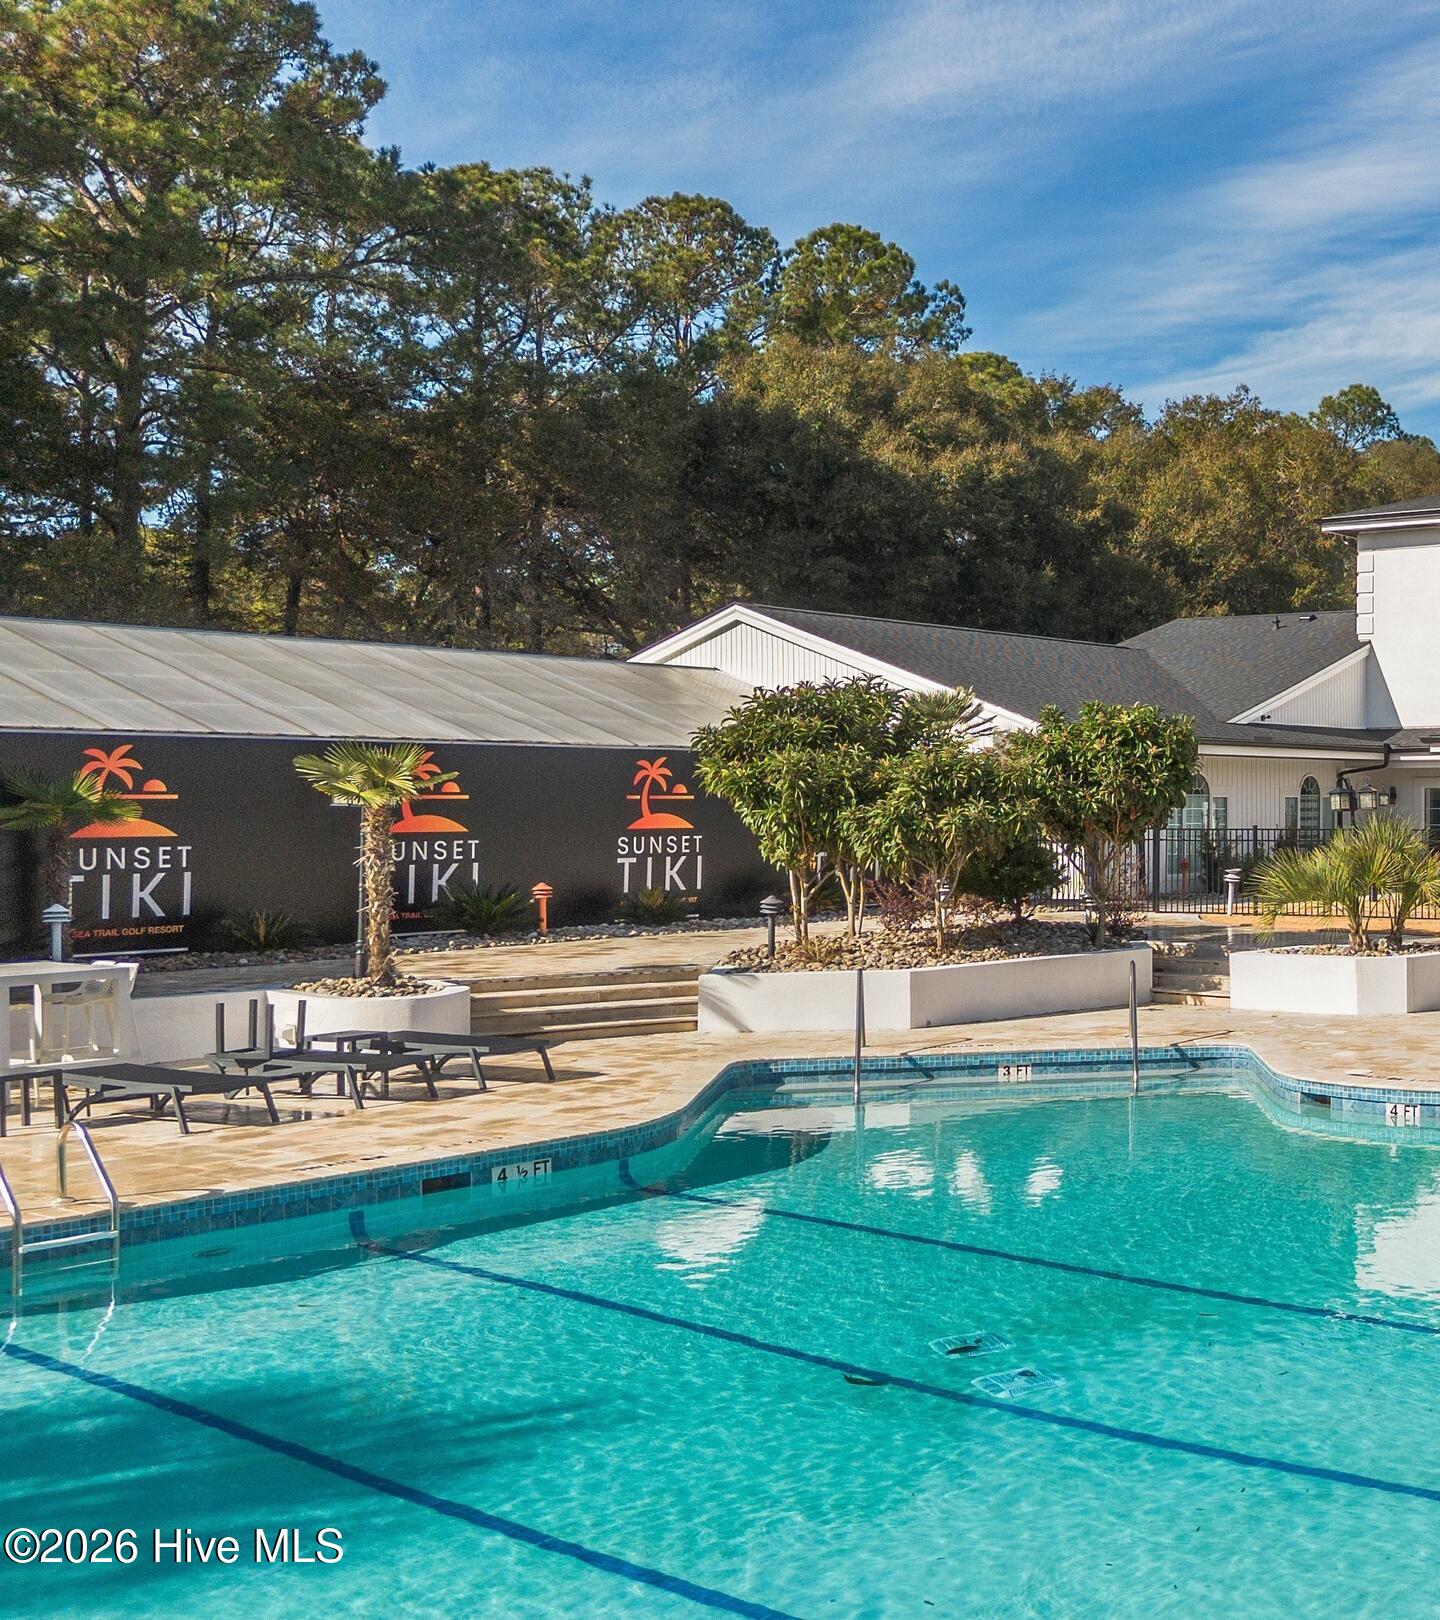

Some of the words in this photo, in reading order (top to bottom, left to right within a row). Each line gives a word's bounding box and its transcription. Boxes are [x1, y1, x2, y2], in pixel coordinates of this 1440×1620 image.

[390, 840, 480, 861] UNSET
[617, 835, 703, 854] SUNSET
[79, 846, 192, 871] UNSET
[407, 862, 479, 904] IKI
[617, 855, 703, 893] TIKI
[94, 928, 120, 937] TRAIL
[121, 926, 147, 936] GOLF
[147, 924, 184, 935] RESORT
[1003, 1065, 1011, 1076] 3
[1017, 1065, 1030, 1076] FT
[1390, 1105, 1398, 1117] 4
[1403, 1105, 1418, 1118] FT
[497, 1167, 508, 1181] 4
[533, 1160, 550, 1176] FT
